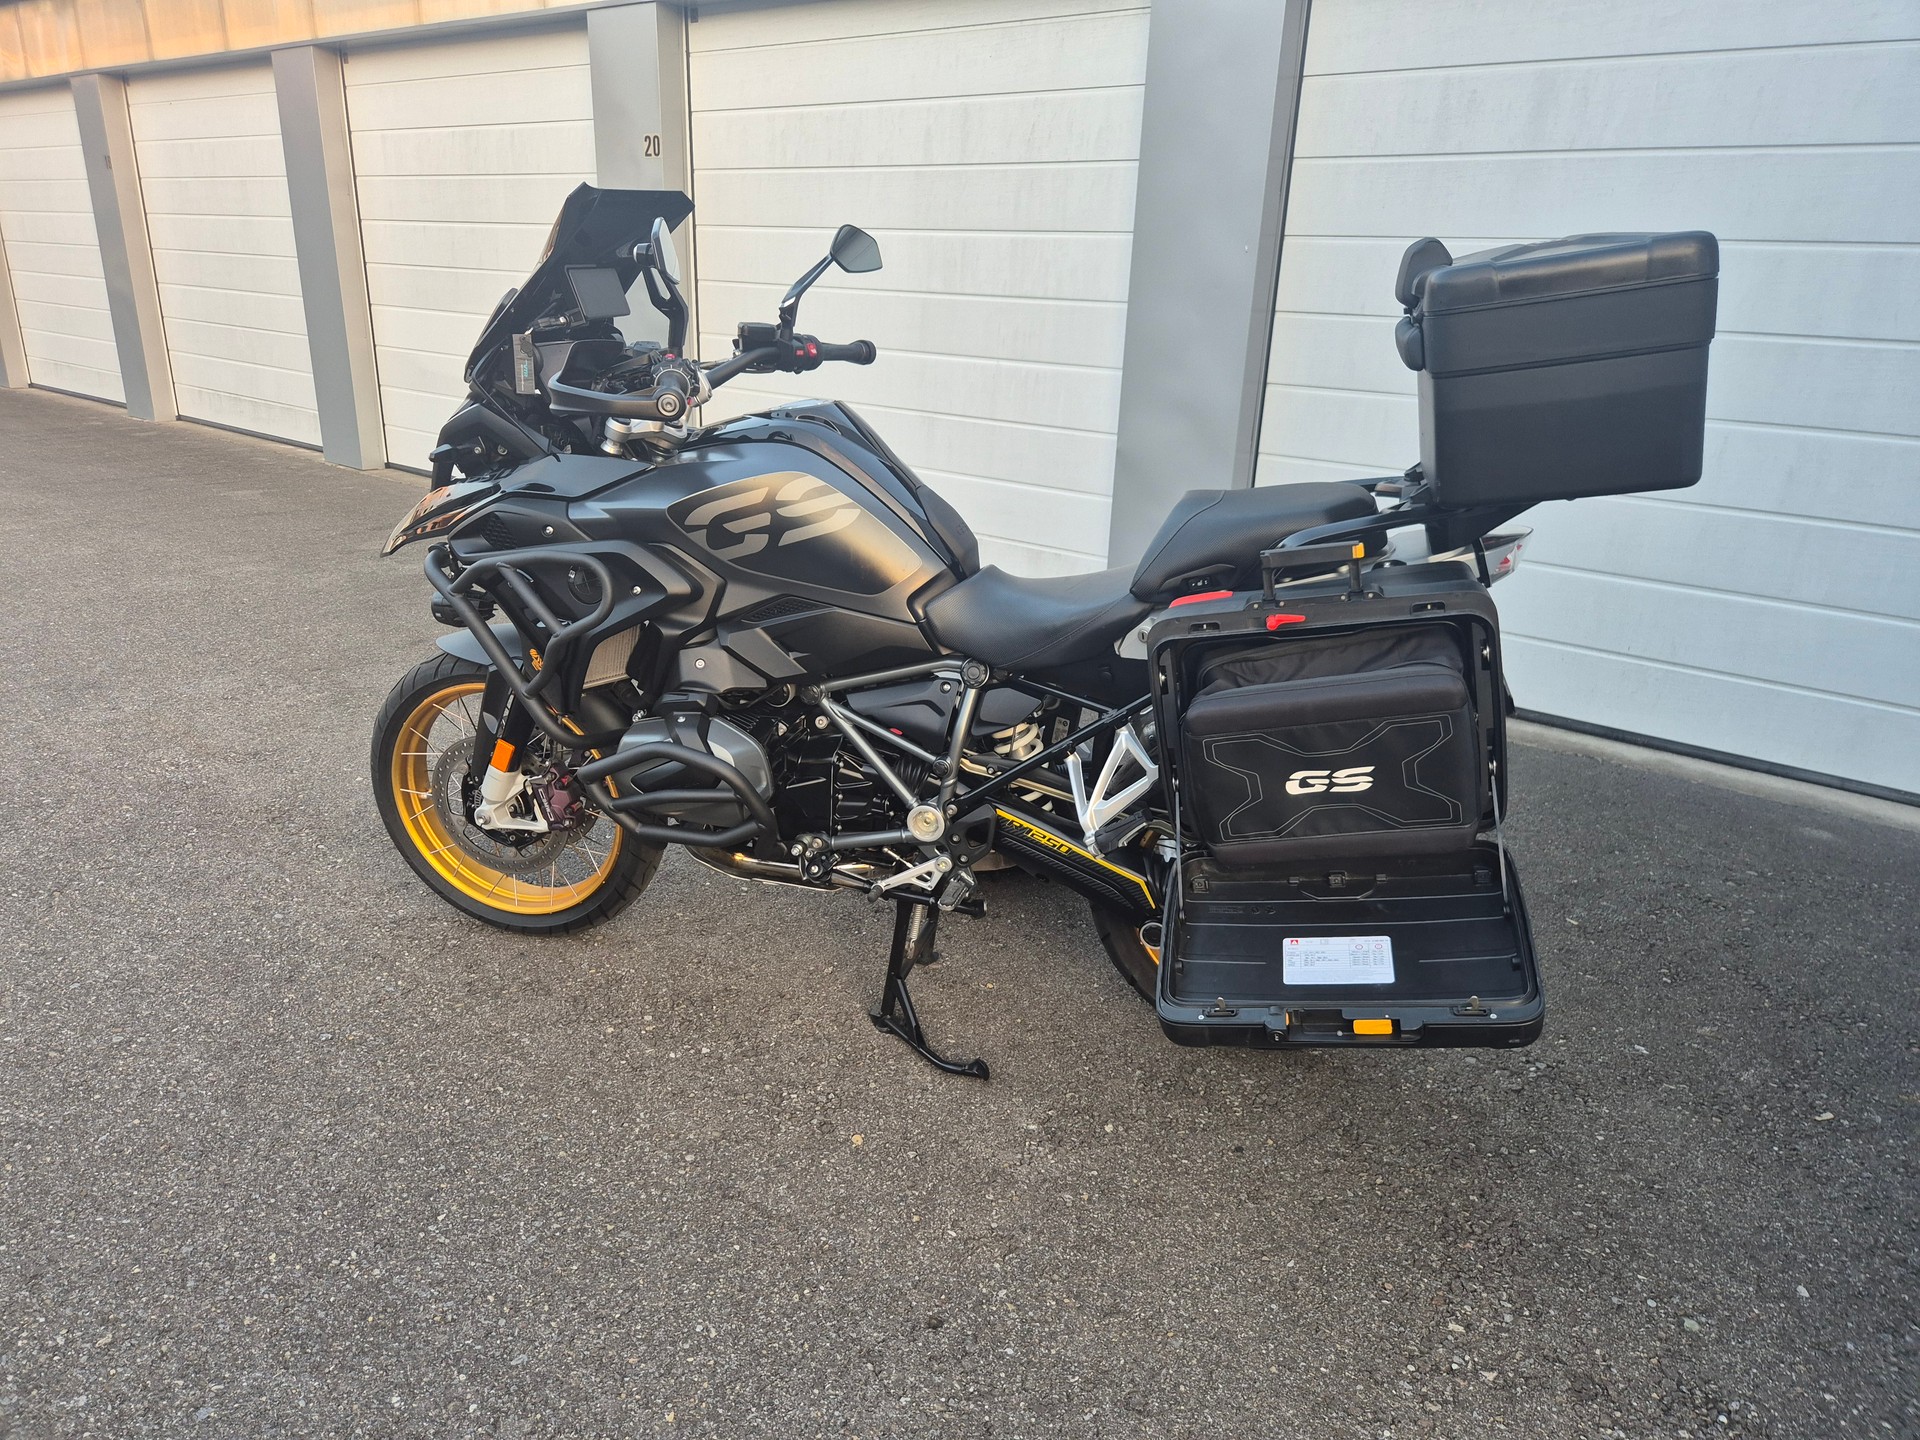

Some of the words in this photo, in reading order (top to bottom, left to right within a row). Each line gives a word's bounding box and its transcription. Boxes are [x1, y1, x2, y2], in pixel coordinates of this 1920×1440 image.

[644, 134, 660, 157] 20
[684, 475, 862, 561] GS
[1285, 766, 1376, 796] GS
[1005, 819, 1073, 856] R1250
